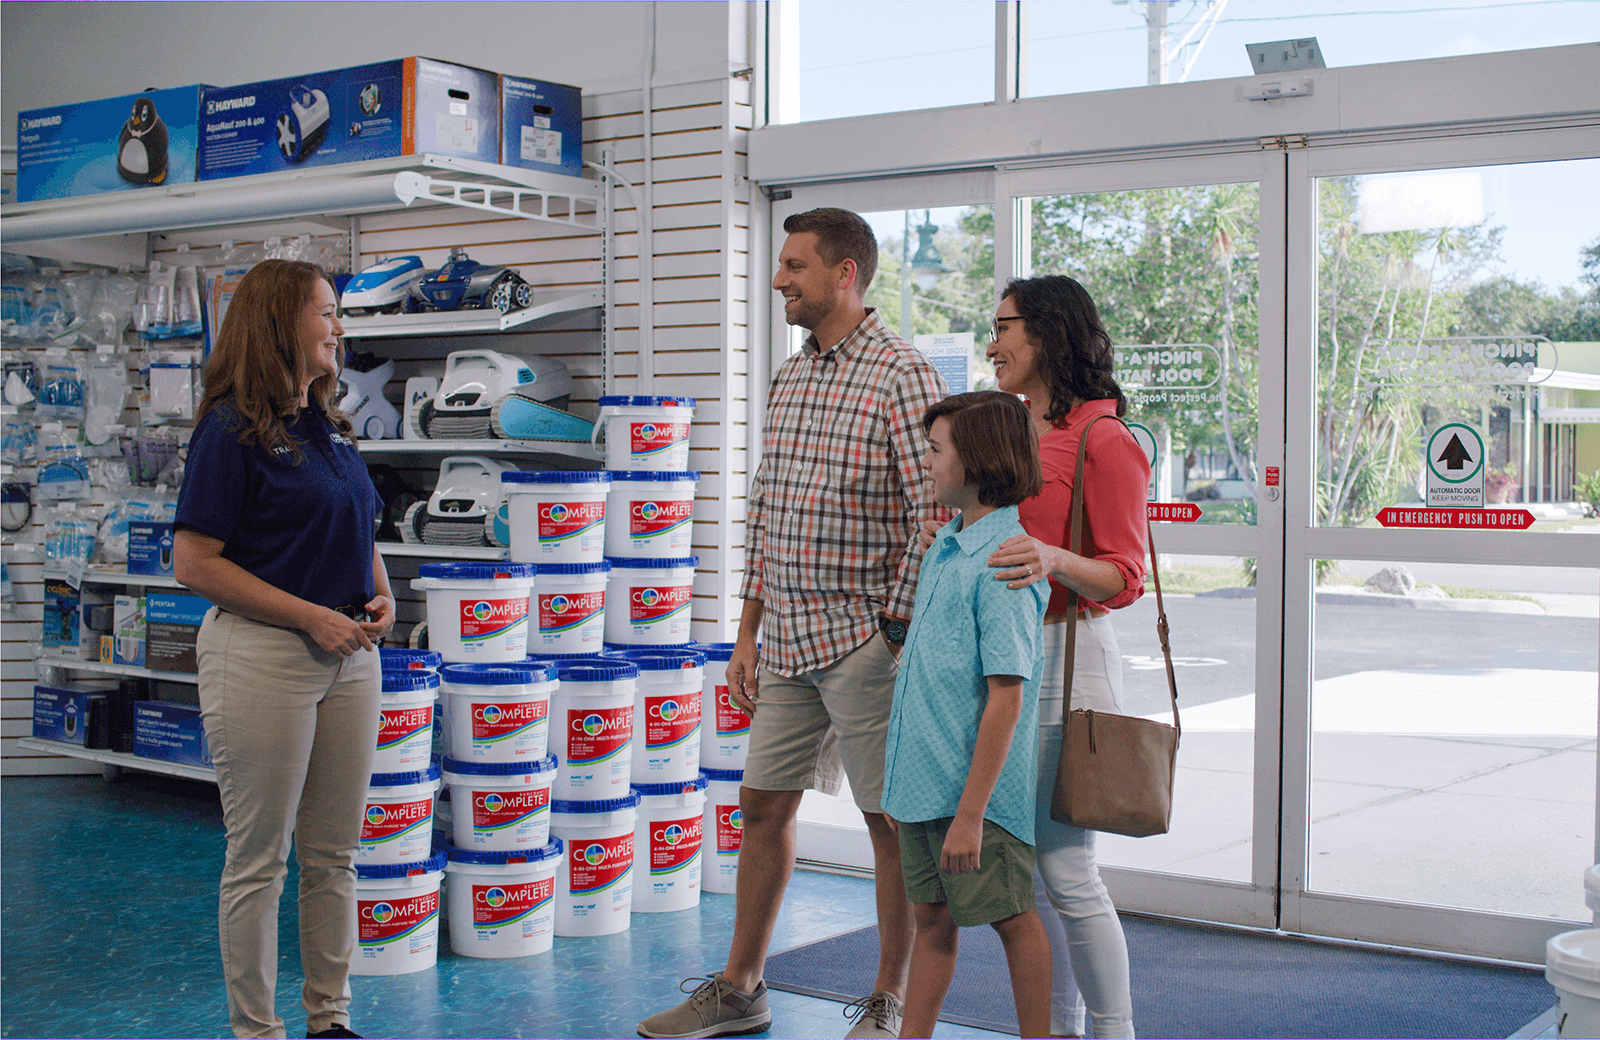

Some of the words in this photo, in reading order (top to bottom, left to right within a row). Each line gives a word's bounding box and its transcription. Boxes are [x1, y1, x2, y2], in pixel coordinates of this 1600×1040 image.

[215, 96, 256, 112] HAYWARD
[28, 115, 62, 128] HAYWARD
[548, 134, 555, 146] 2
[633, 424, 687, 441] COMPLETE
[541, 504, 603, 522] COMPLETE
[633, 502, 690, 520] COMPLETE
[1148, 507, 1157, 517] SH
[1160, 507, 1169, 518] TO
[1172, 507, 1192, 518] OPEN
[1387, 512, 1397, 523] IN
[1400, 512, 1452, 524] EMERGENCY
[1459, 513, 1483, 525] PUSH
[1486, 513, 1497, 525] TO
[1500, 513, 1524, 525] OPEN
[541, 595, 603, 614] COMPLETE
[633, 588, 690, 606] COMPLETE
[464, 601, 527, 620] COMPLETE
[379, 712, 427, 731] MPLETE
[475, 705, 541, 723] COMPLETE
[476, 793, 544, 812] COMPLETE
[364, 805, 427, 825] OMPLETE
[654, 822, 703, 845] COMPLE
[523, 880, 550, 890] SUNCOAST
[412, 893, 436, 903] SUNCOAST
[476, 884, 549, 907] COMPLETE
[362, 898, 436, 923] COMPLETE
